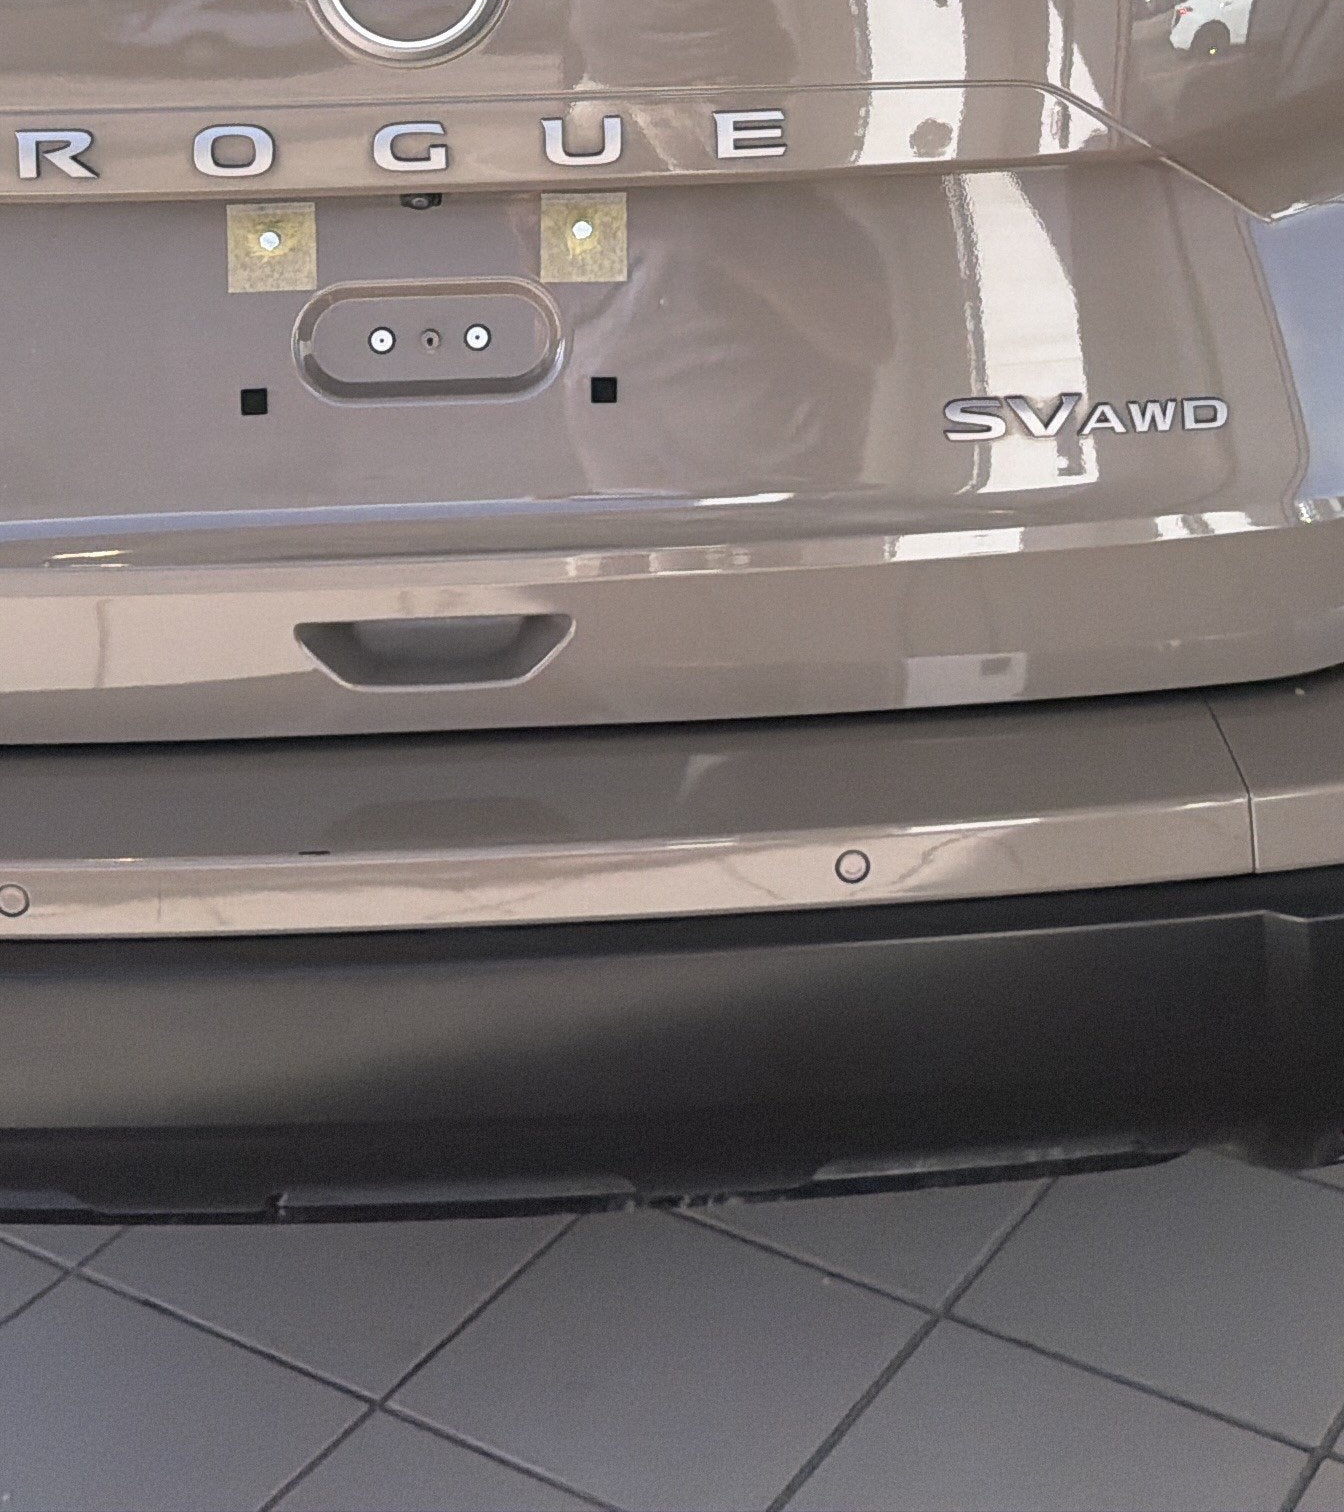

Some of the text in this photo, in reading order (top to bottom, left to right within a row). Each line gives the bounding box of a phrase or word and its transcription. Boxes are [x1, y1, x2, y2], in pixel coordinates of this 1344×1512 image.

[14, 108, 789, 181] ROGUE
[942, 392, 1230, 442] SV AWD
